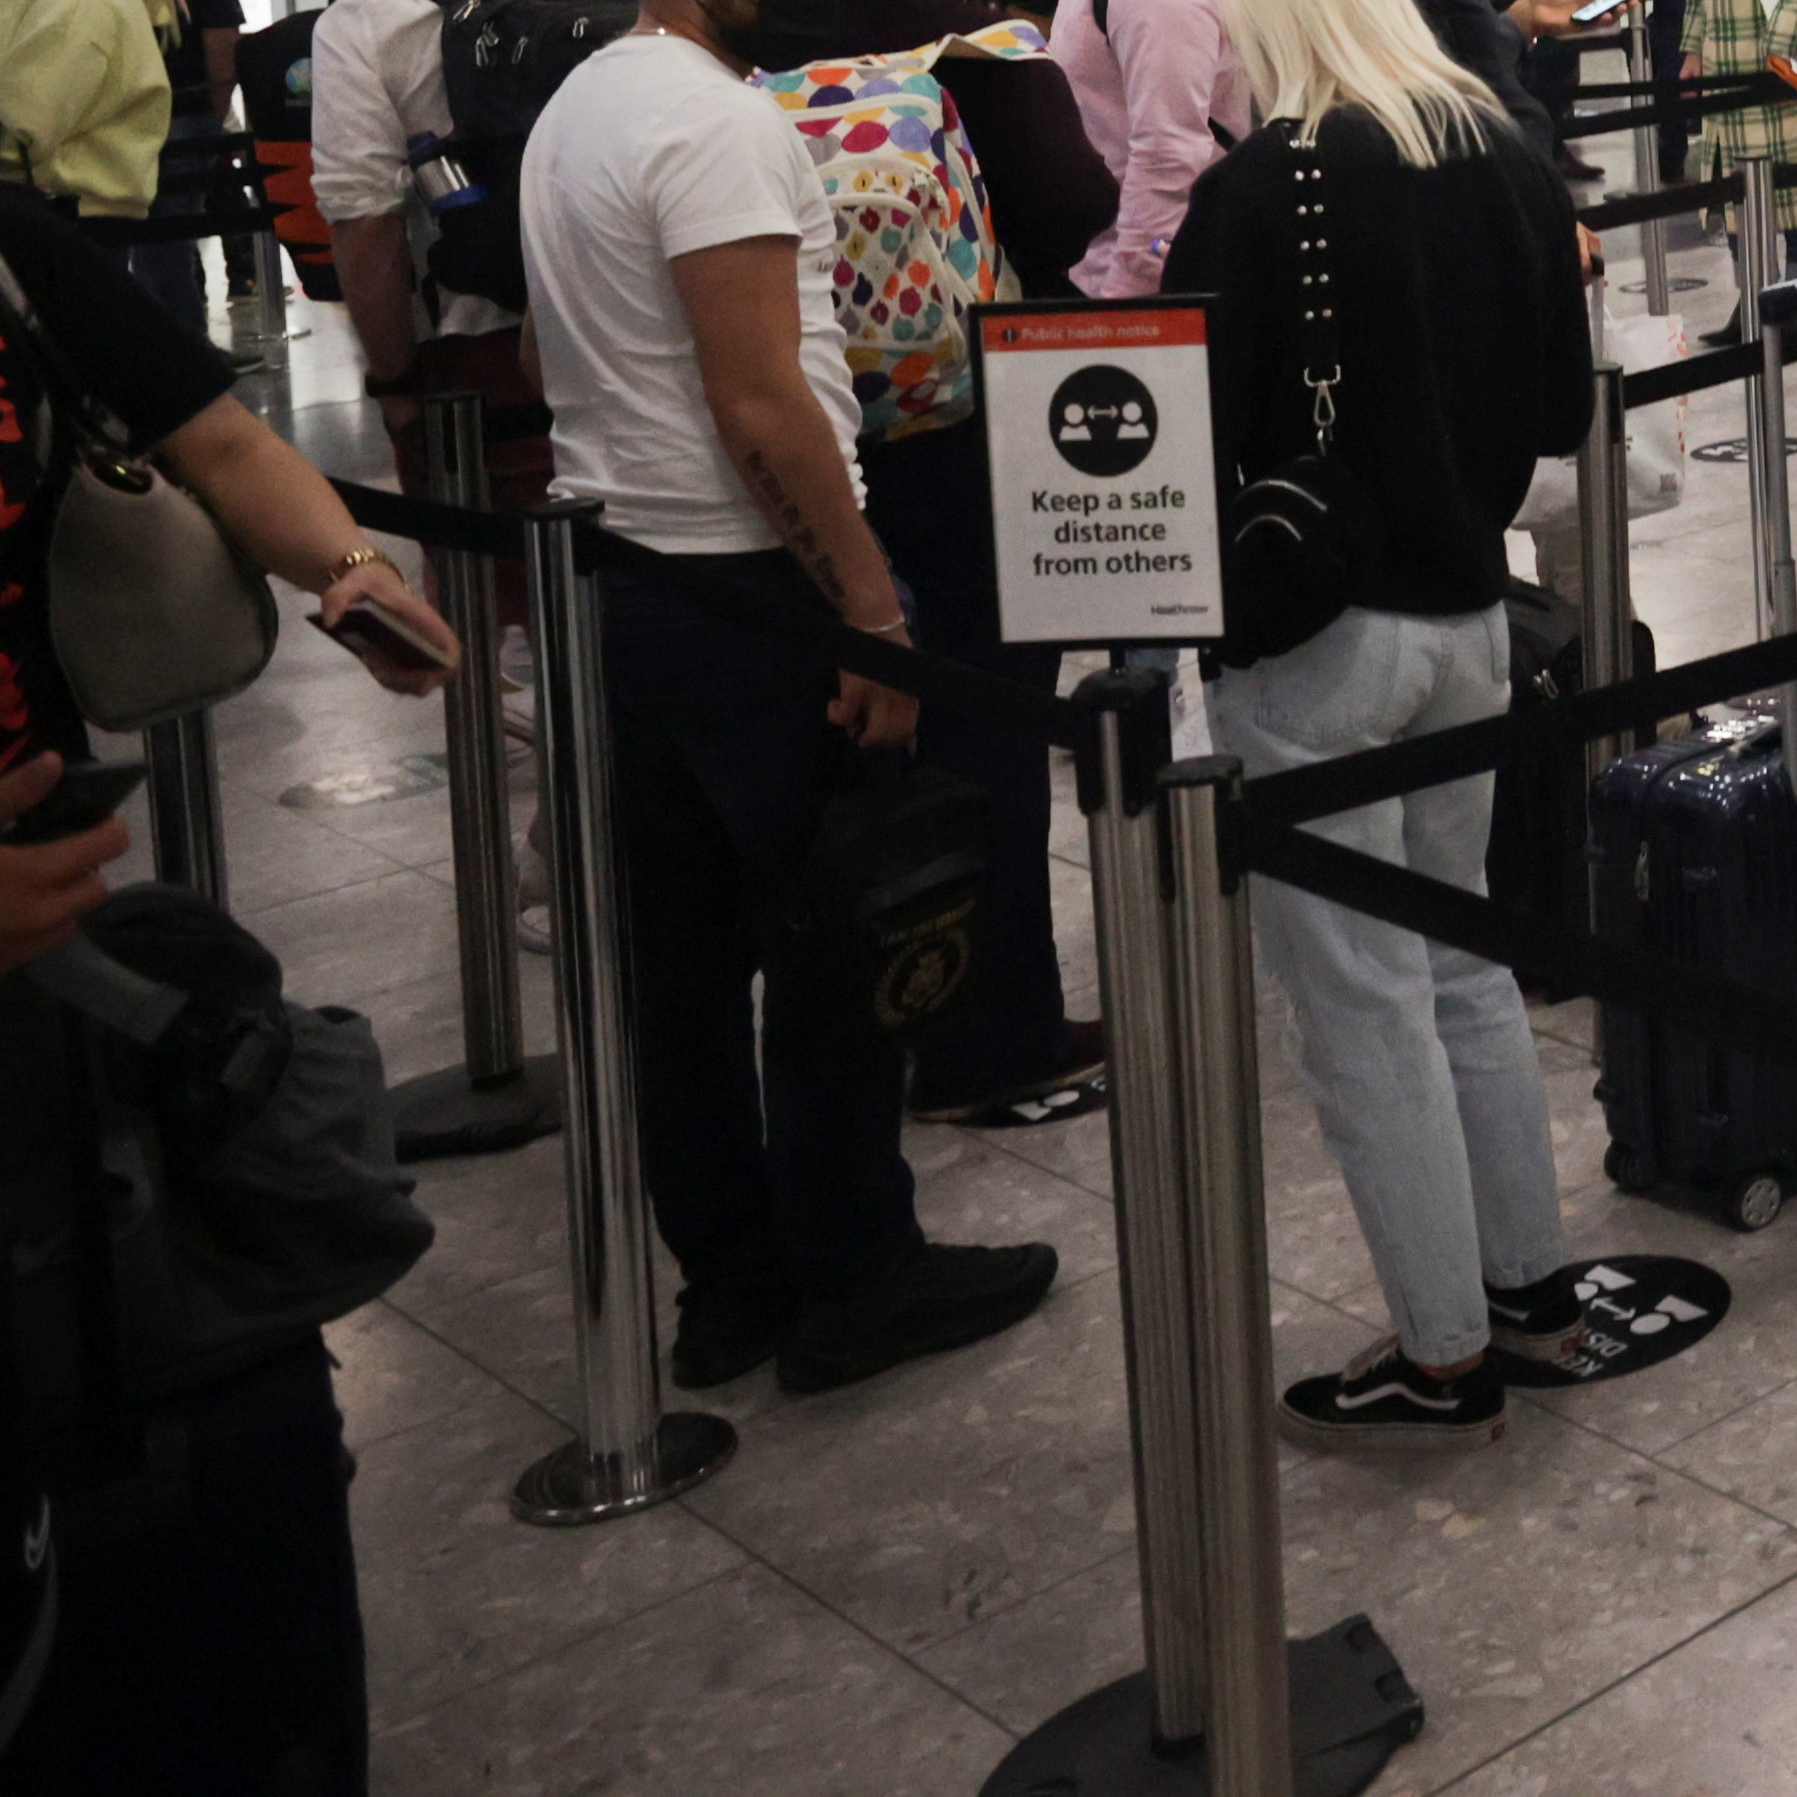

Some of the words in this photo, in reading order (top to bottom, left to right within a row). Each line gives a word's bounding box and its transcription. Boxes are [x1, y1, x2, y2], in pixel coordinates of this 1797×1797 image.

[1021, 327, 1064, 340] Public
[1068, 325, 1113, 338] health
[1117, 324, 1161, 337] notice
[1032, 490, 1099, 515] Keep
[1107, 493, 1123, 511] a
[1130, 485, 1185, 511] safe
[1054, 520, 1166, 544] distance
[1033, 553, 1098, 576] from
[1105, 550, 1192, 573] others
